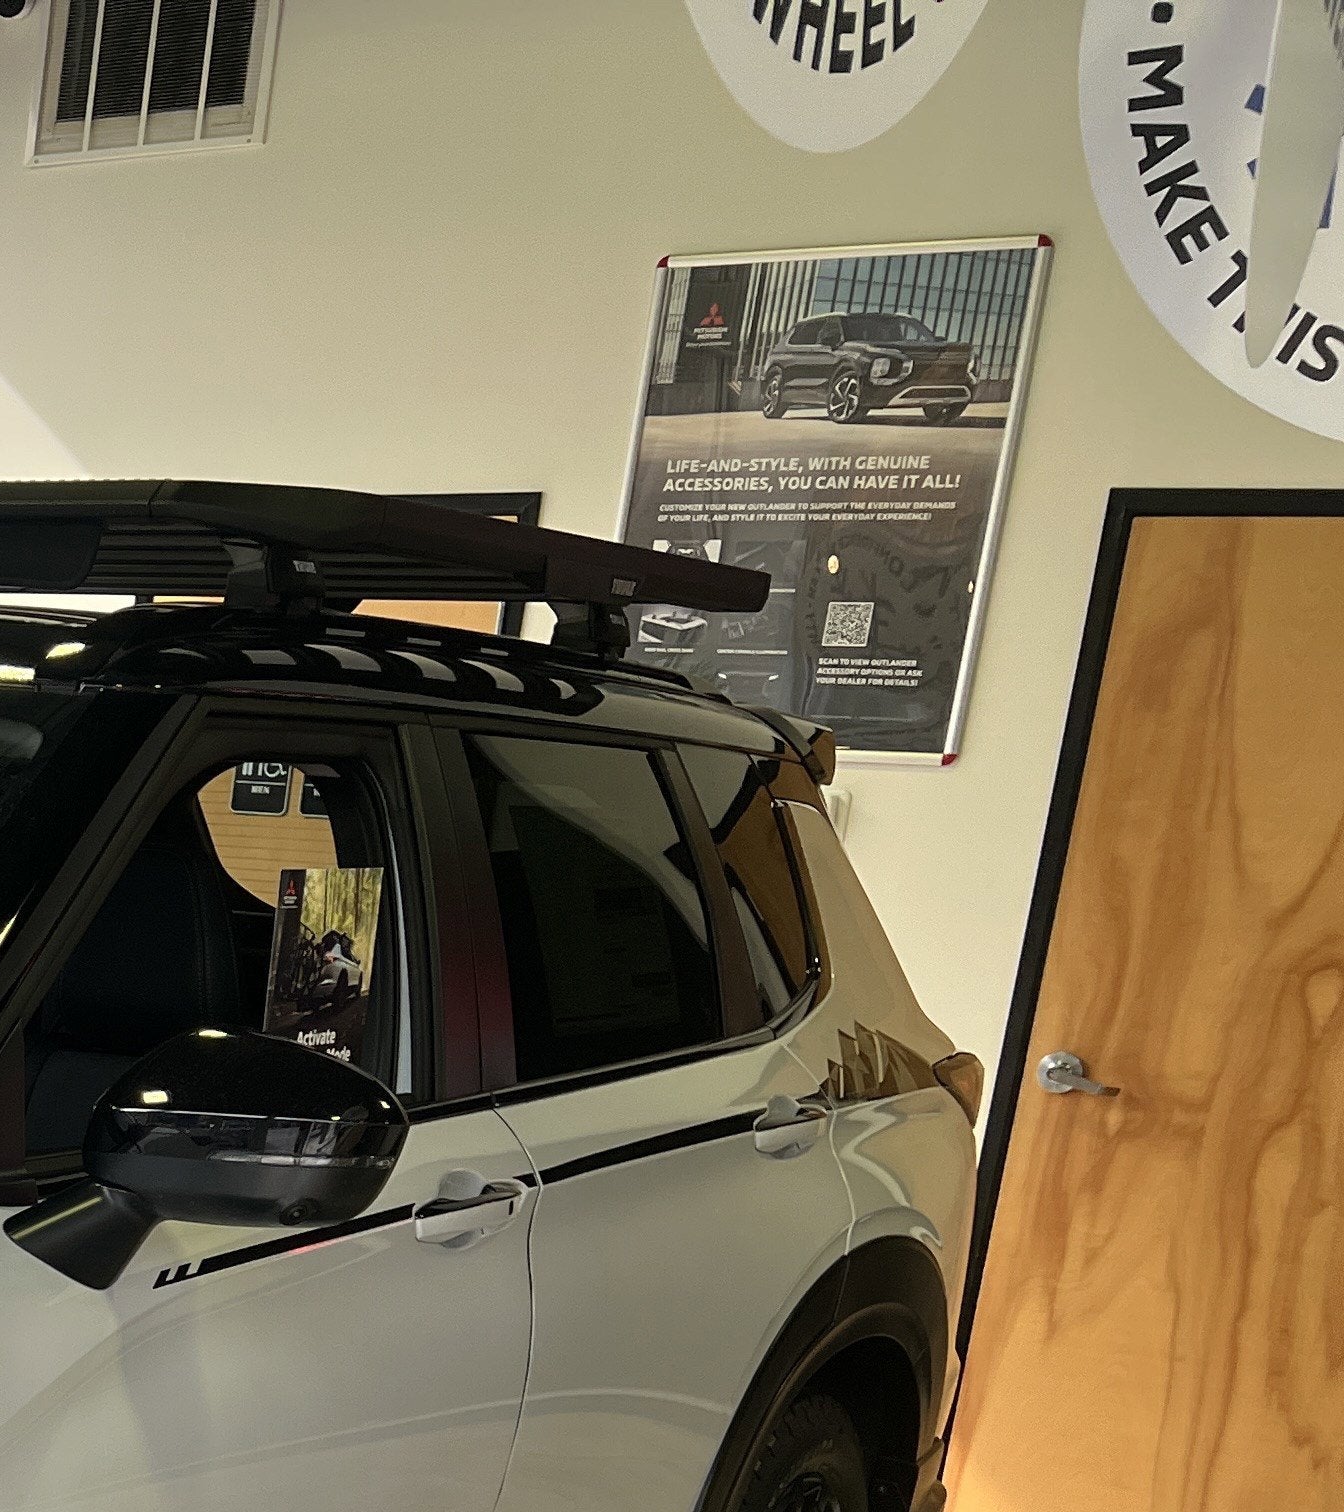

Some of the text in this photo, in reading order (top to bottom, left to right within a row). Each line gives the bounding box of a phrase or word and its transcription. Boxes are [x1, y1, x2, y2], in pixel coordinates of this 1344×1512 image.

[1127, 44, 1344, 383] MAKE TIS
[666, 455, 931, 474] LIFE-AND-STYLE, WITH GENUINE
[663, 474, 962, 493] ACCESSORIES, YOU CAN HAVE IT ALL!
[297, 1028, 337, 1047] Activate
